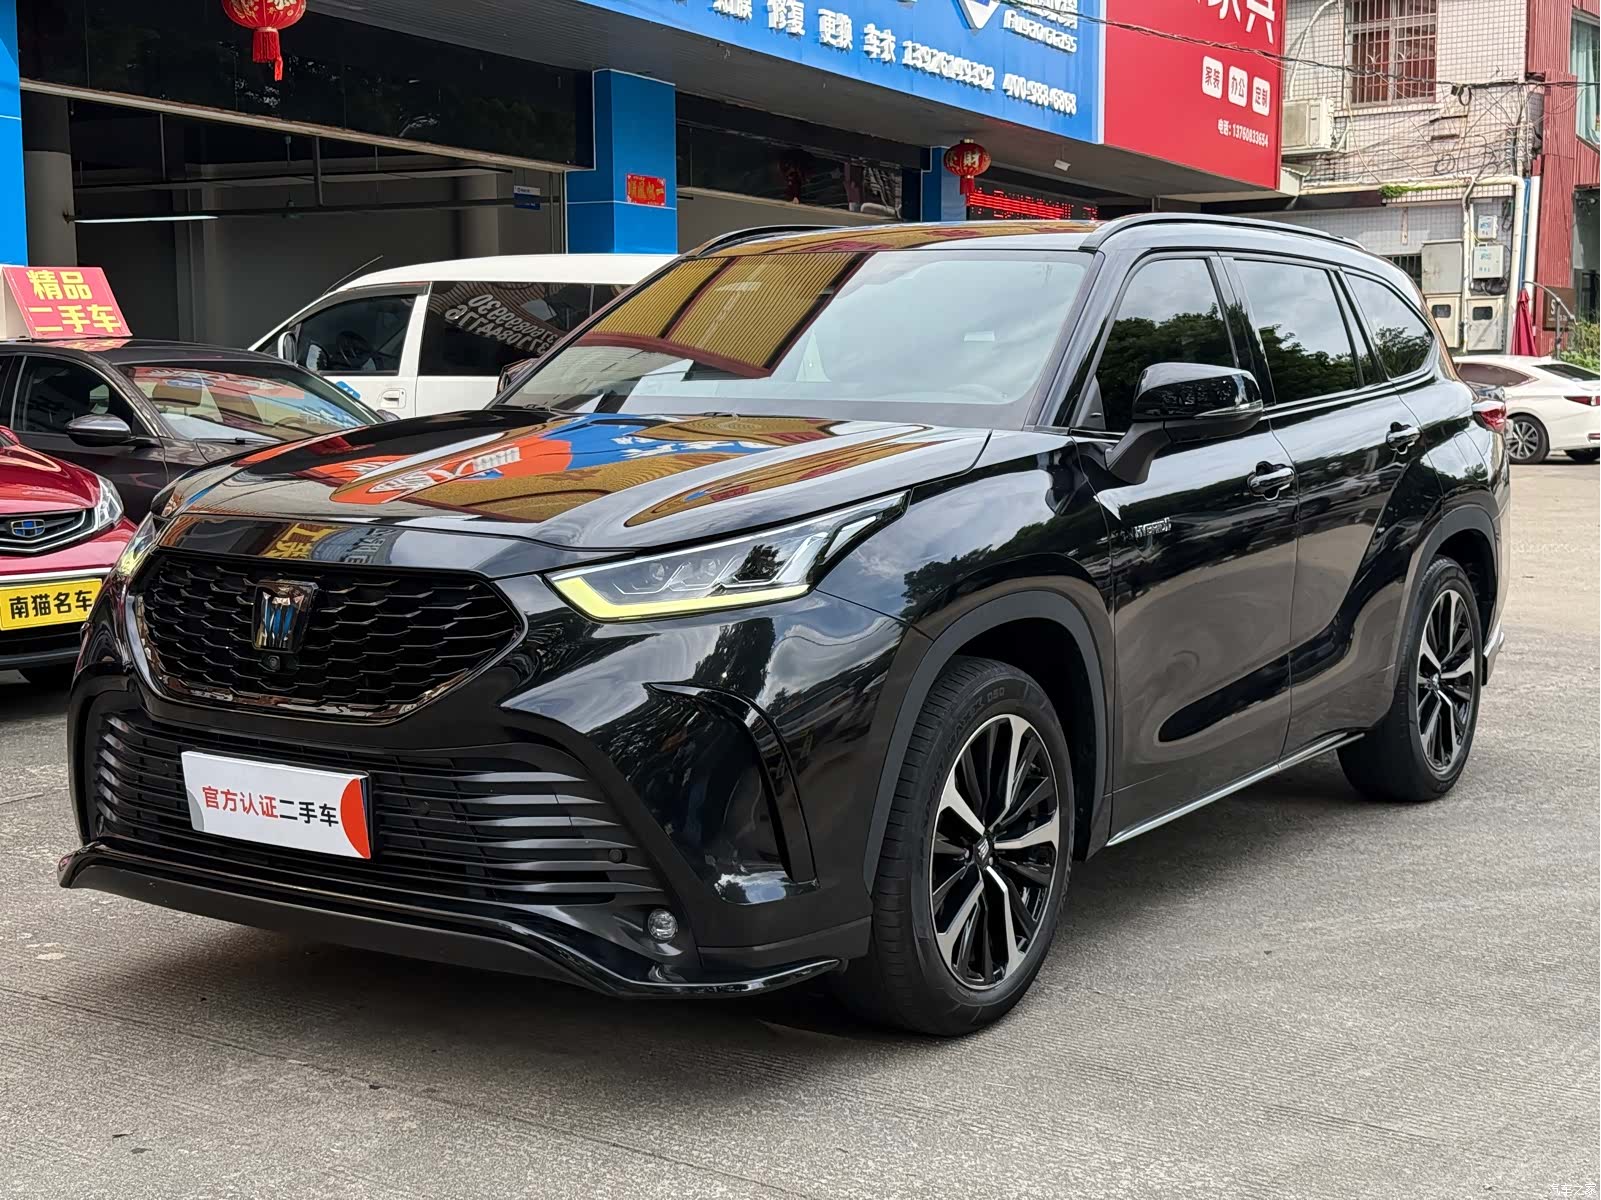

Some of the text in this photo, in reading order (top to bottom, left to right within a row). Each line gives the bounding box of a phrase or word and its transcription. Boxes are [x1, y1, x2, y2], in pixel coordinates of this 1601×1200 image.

[818, 8, 853, 50] 更换
[1205, 65, 1268, 108] 家装 办公 定制
[26, 270, 93, 300] 精品
[28, 304, 121, 333] 二手车
[9, 590, 93, 619] 南猫名车
[202, 785, 339, 827] 官方认证二手车
